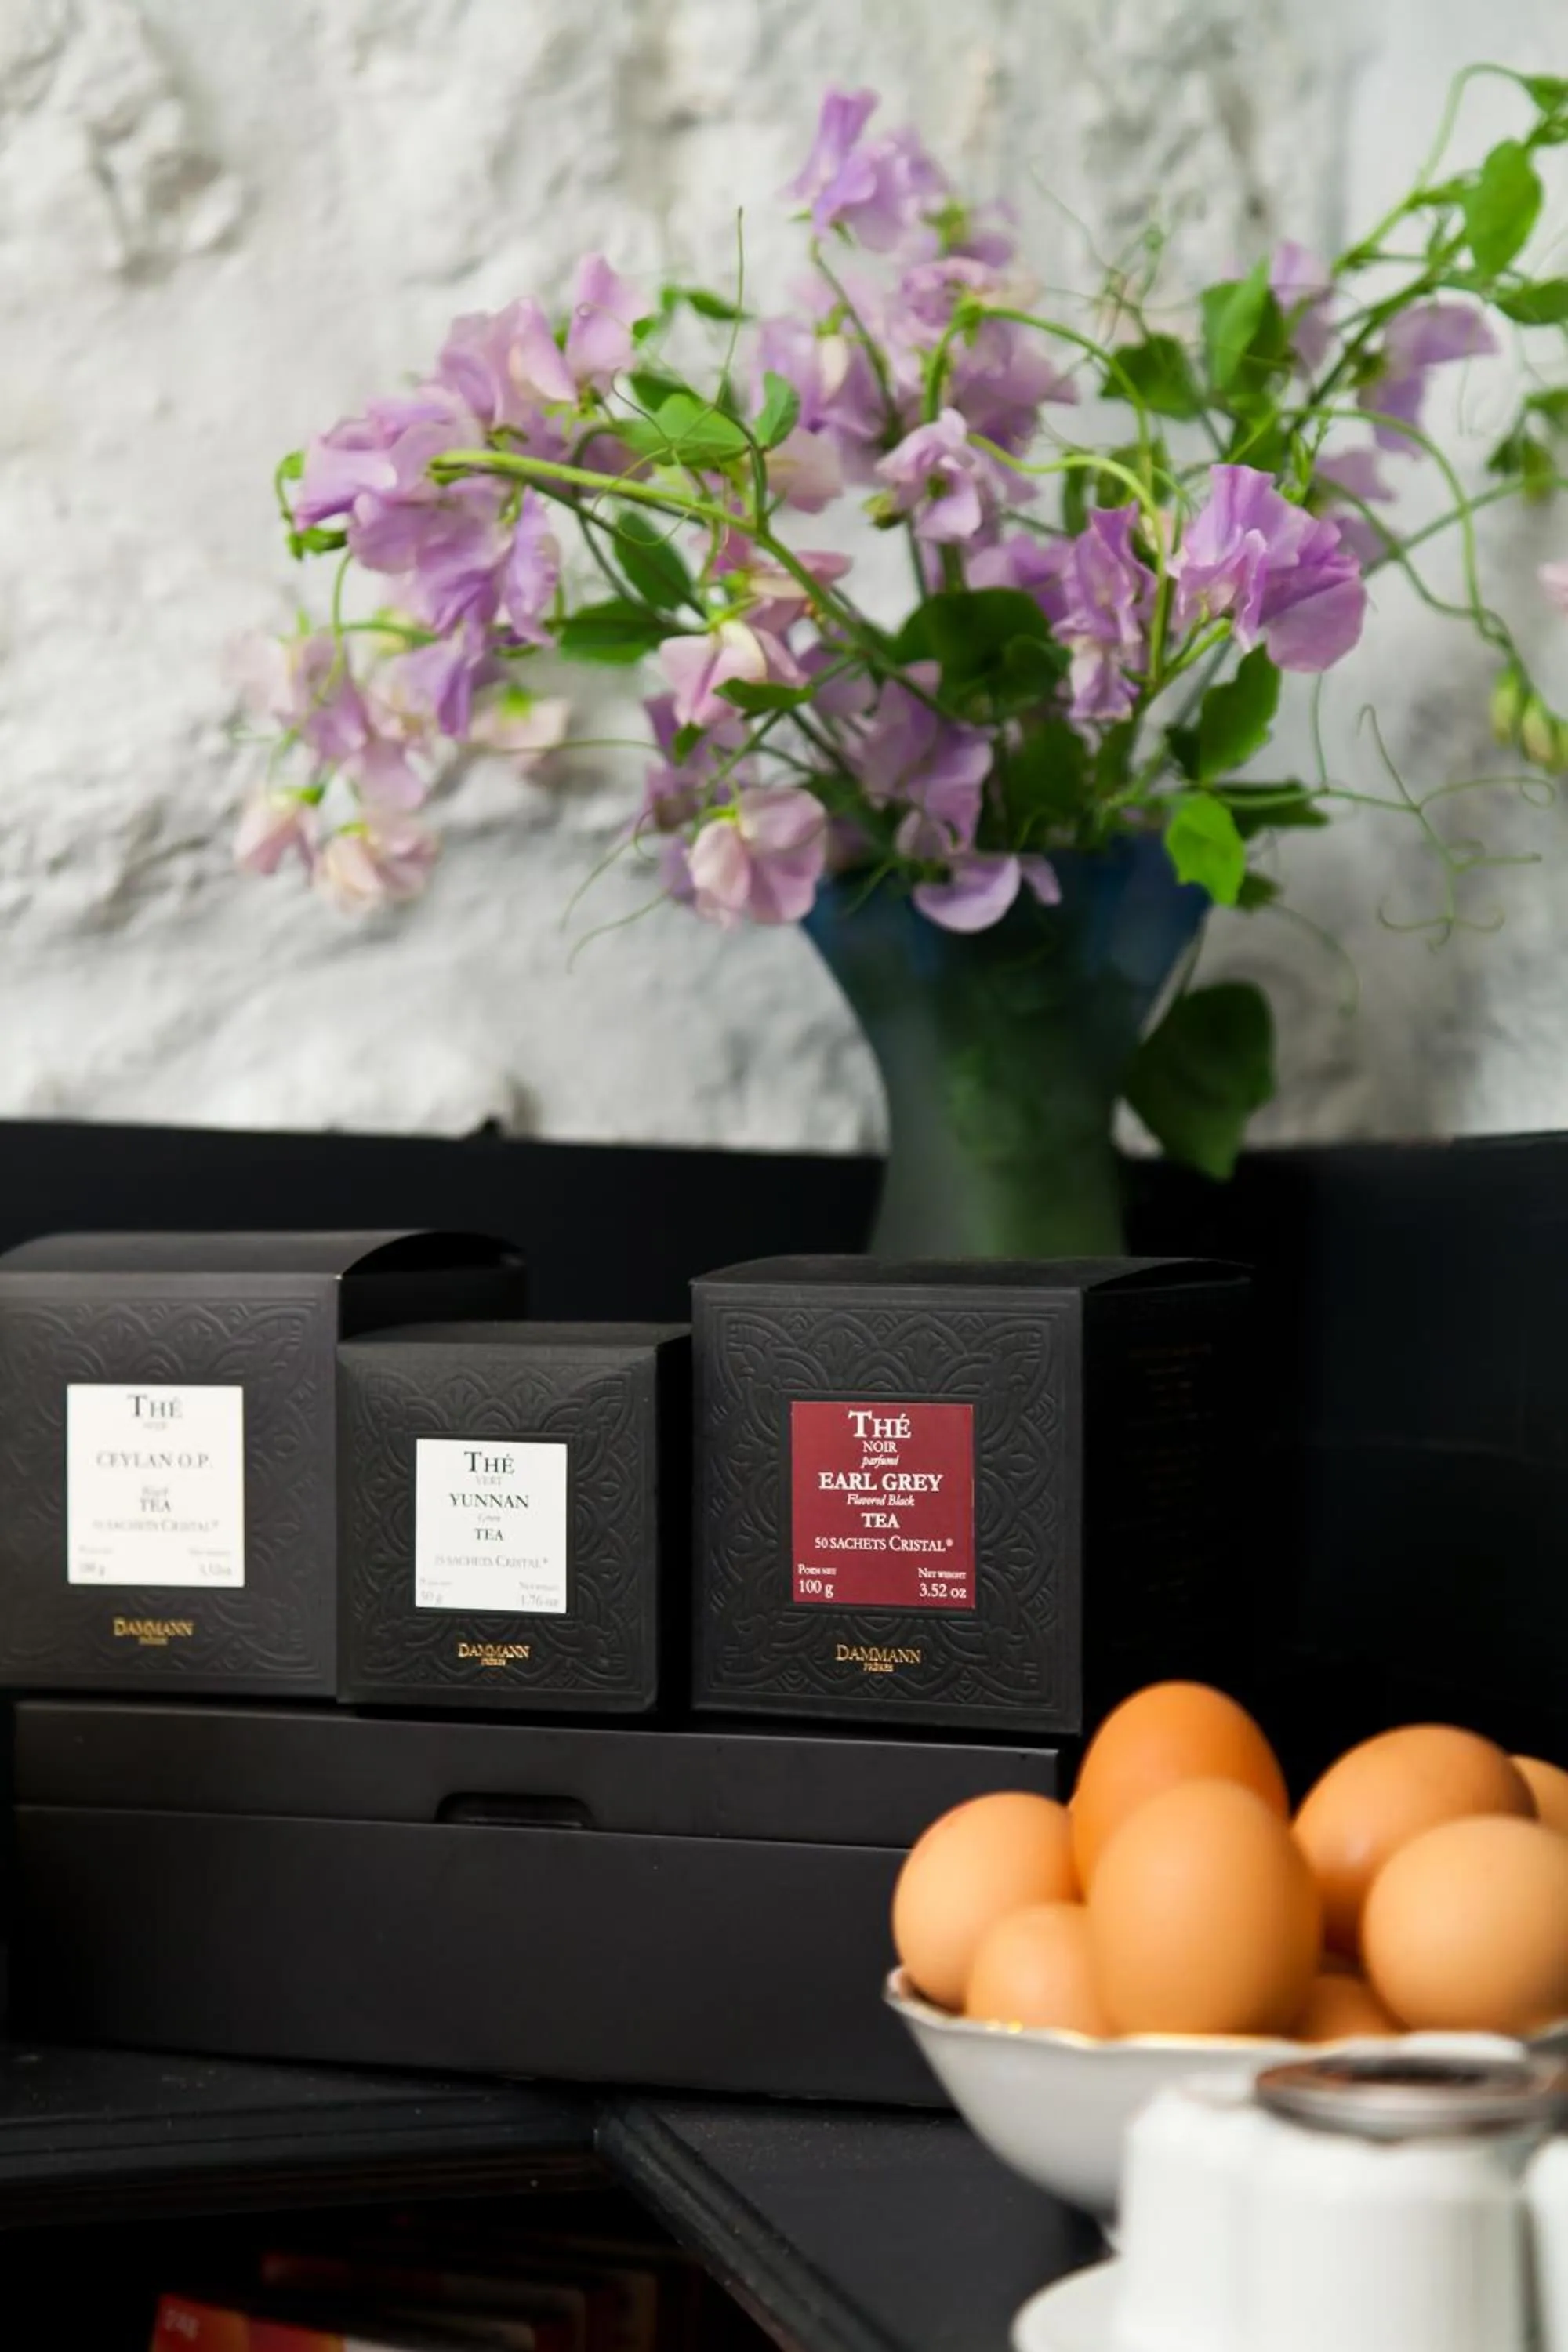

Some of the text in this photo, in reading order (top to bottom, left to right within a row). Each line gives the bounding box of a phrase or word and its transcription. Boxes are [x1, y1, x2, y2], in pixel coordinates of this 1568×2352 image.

[848, 1410, 911, 1439] THÉ
[862, 1441, 897, 1453] NOIR
[463, 1451, 515, 1475] THÉ
[818, 1472, 944, 1493] EARL GREY
[140, 1497, 172, 1513] TEA
[449, 1492, 529, 1510] YUNNAN
[847, 1494, 915, 1507] Flavored Black
[861, 1512, 900, 1529] TEA
[474, 1528, 504, 1541] TEA
[815, 1537, 829, 1549] 50
[830, 1537, 887, 1550] SACHETS
[799, 1579, 834, 1599] 100 g
[919, 1582, 967, 1599] 3.52 oz
[113, 1616, 194, 1636] DAMMANN
[457, 1642, 531, 1659] DAMMANN
[835, 1643, 921, 1664] DAMMANN
